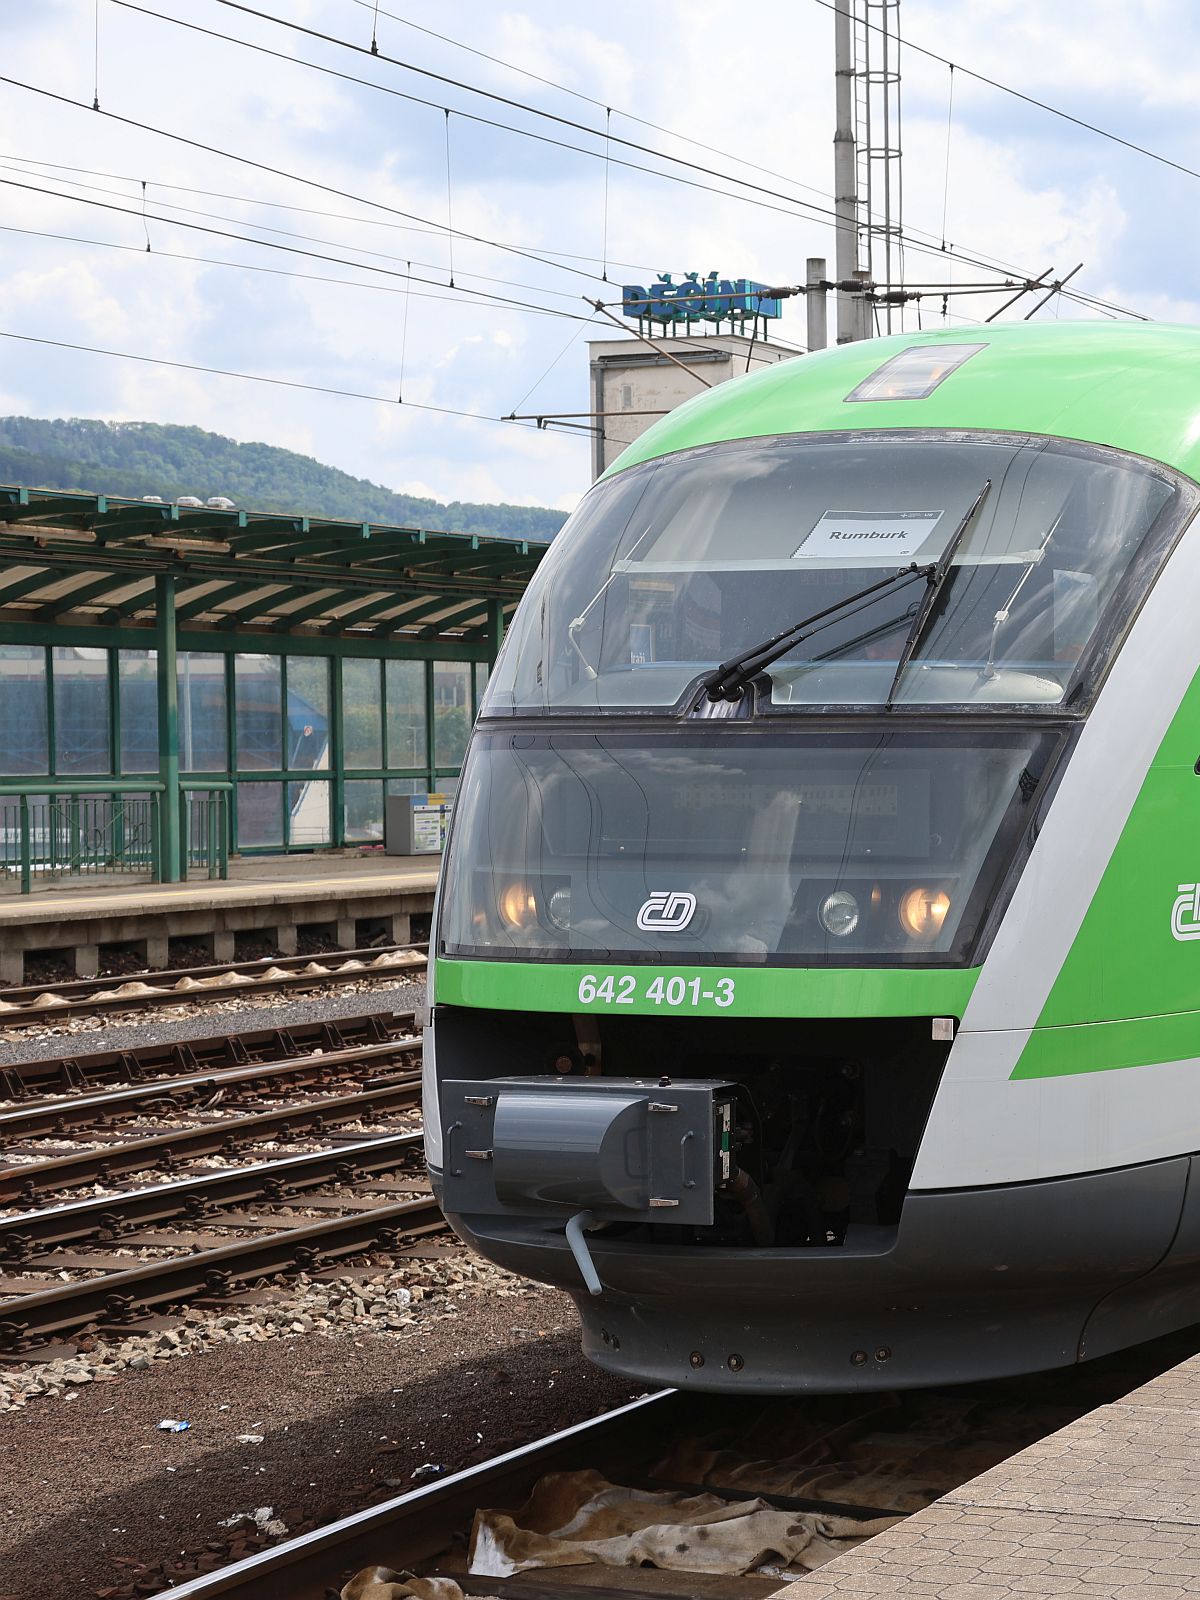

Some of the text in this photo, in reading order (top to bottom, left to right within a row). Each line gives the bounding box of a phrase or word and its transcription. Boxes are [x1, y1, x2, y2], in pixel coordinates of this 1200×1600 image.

[623, 271, 753, 319] DĚČÍN
[829, 530, 908, 540] Rumburk
[578, 975, 735, 1007] 642 401-3
